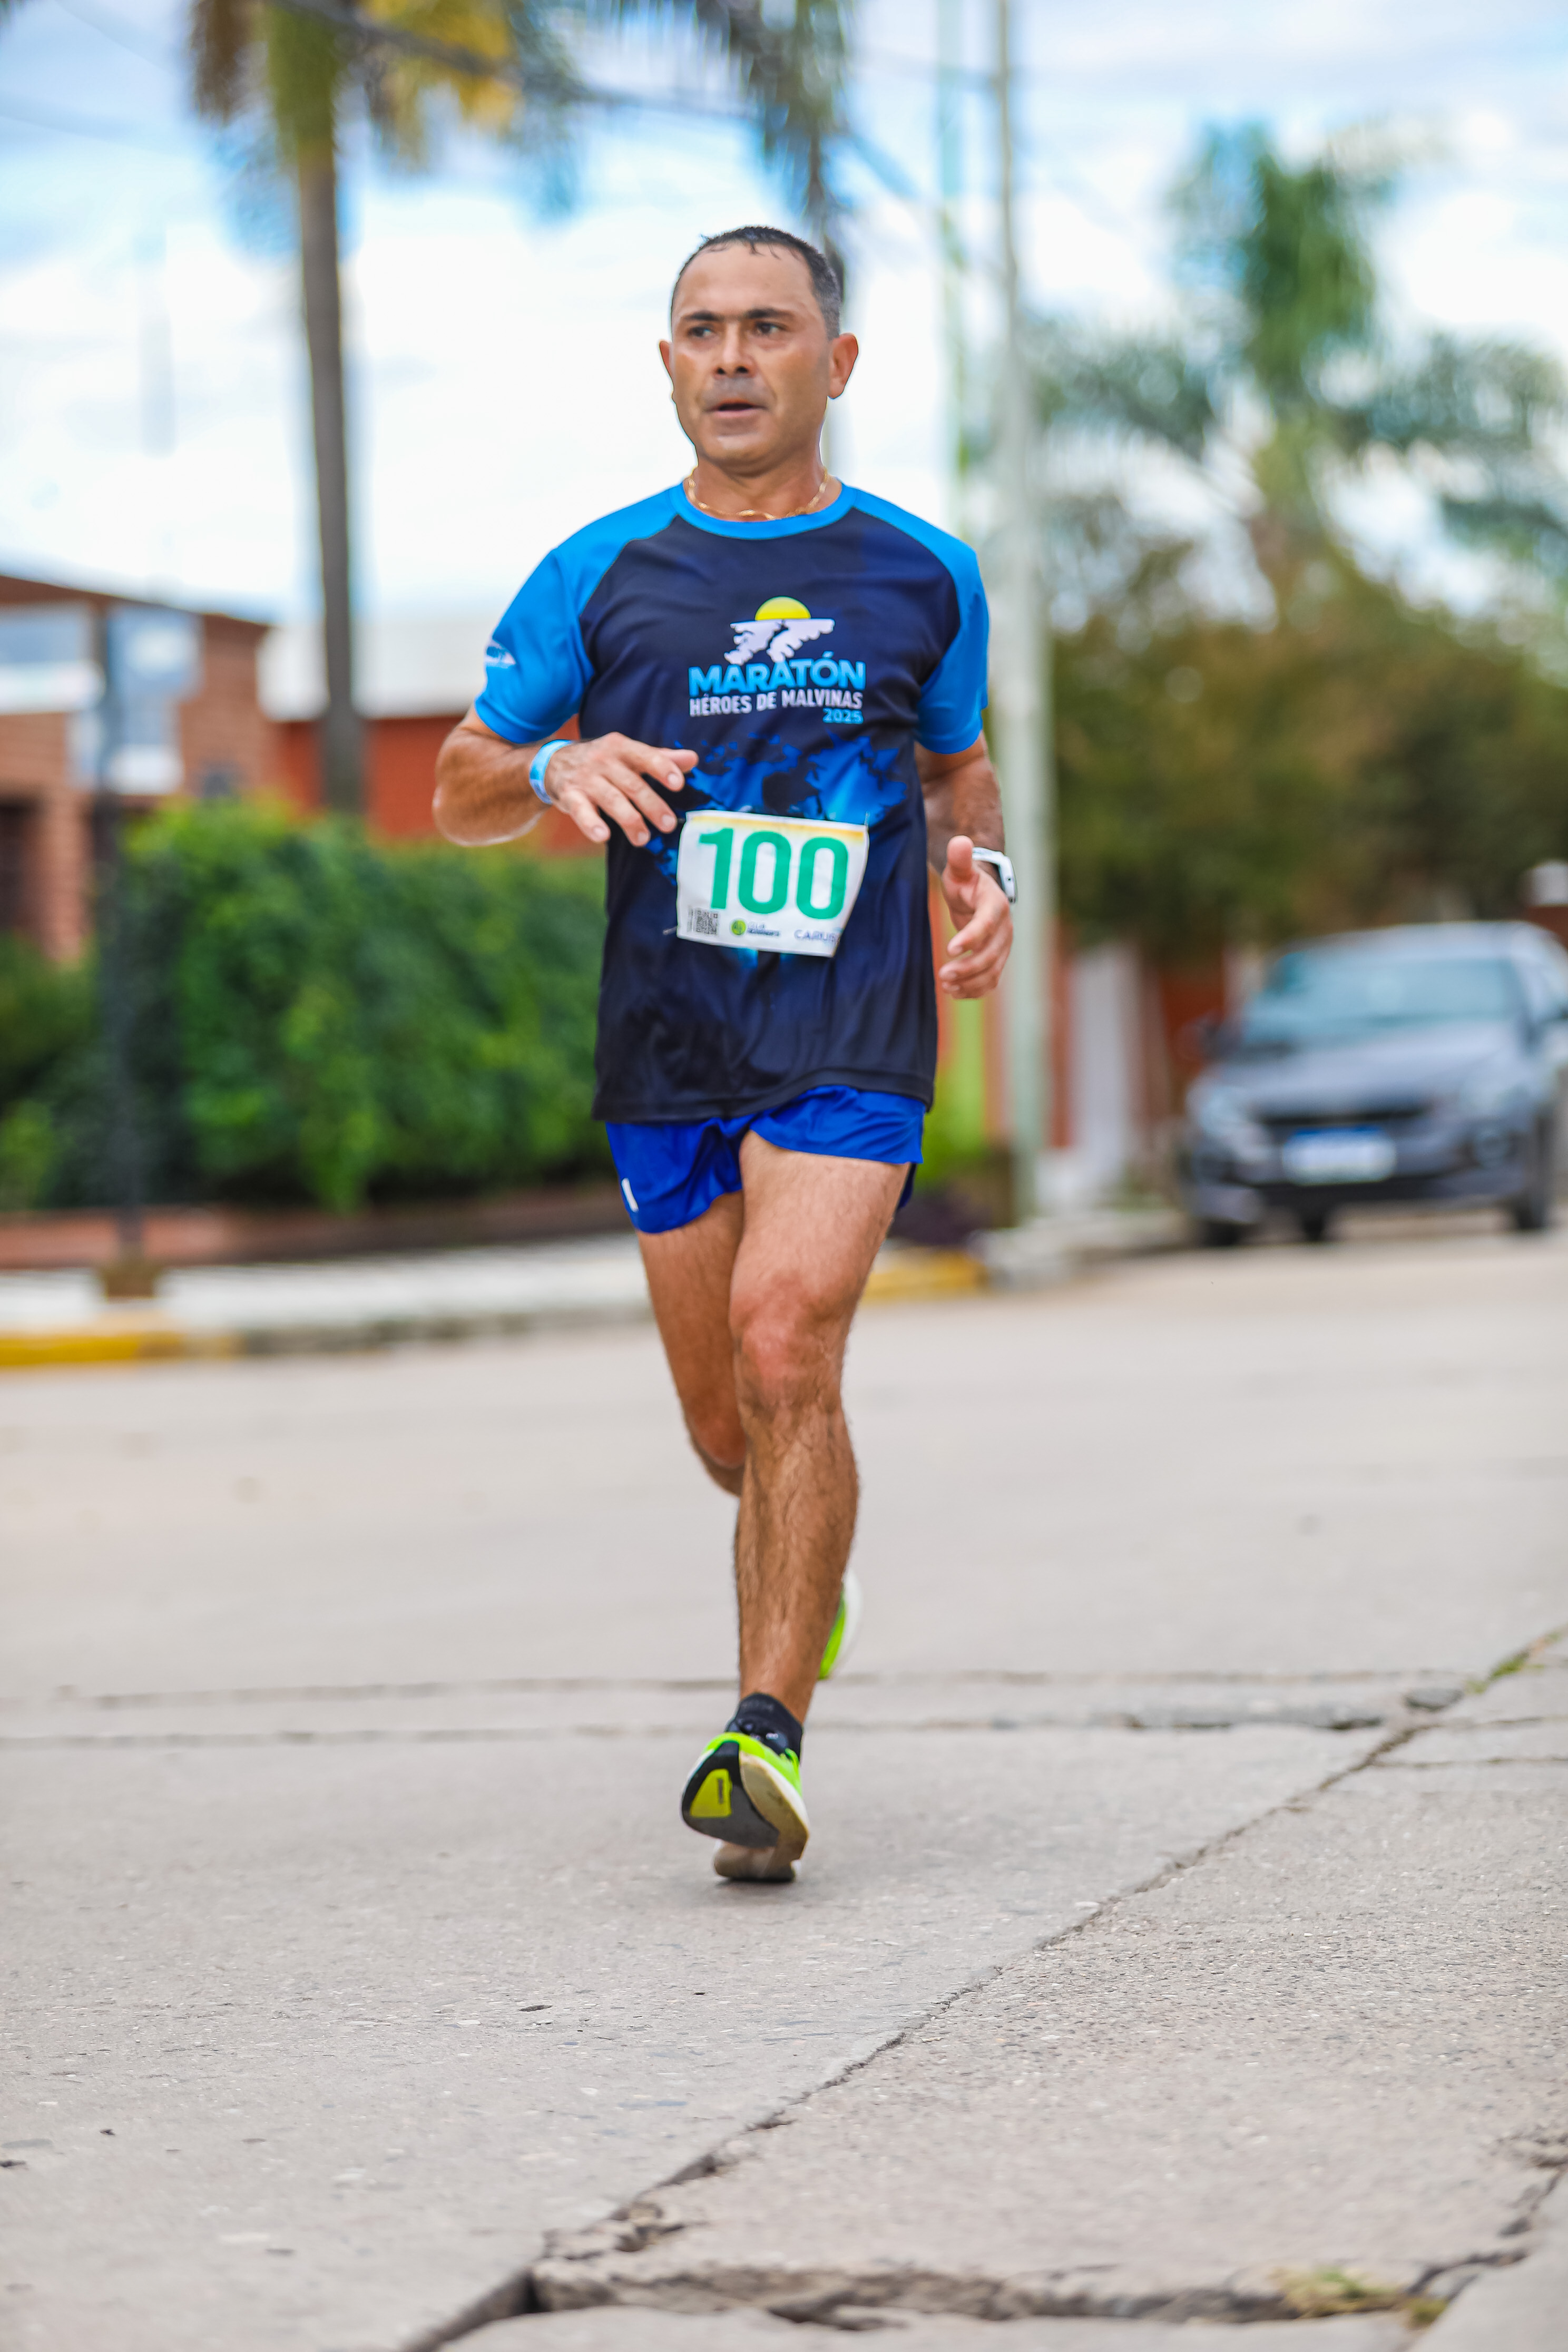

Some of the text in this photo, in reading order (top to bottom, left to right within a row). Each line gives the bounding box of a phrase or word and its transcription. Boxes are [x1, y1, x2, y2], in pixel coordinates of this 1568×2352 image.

[688, 651, 866, 696] MARATÓN
[689, 689, 863, 717] HÉROES DE MALVINAS
[822, 708, 864, 724] 2025
[699, 828, 848, 919] 100
